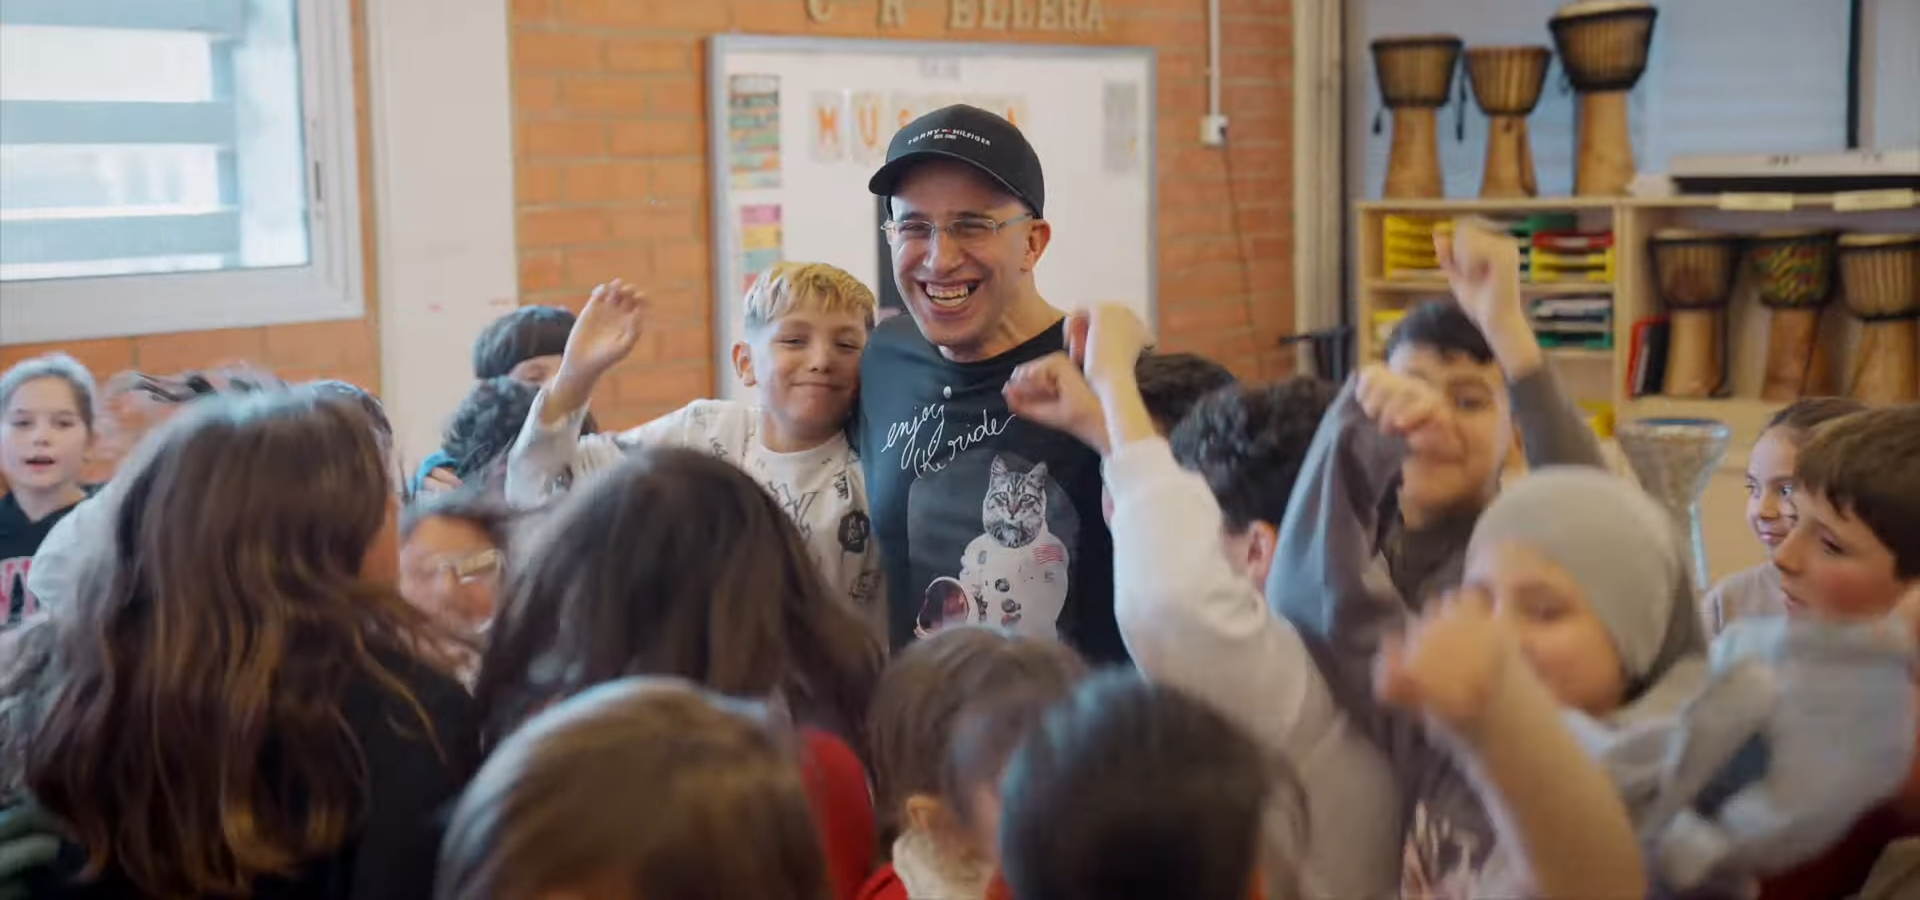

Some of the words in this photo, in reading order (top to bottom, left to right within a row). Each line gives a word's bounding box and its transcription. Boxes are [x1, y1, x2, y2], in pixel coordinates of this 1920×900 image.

[908, 128, 940, 146] TOMMY
[952, 128, 991, 147] HILFIGER
[881, 402, 945, 470] enjoy
[913, 438, 947, 478] the
[947, 408, 1017, 461] ride
